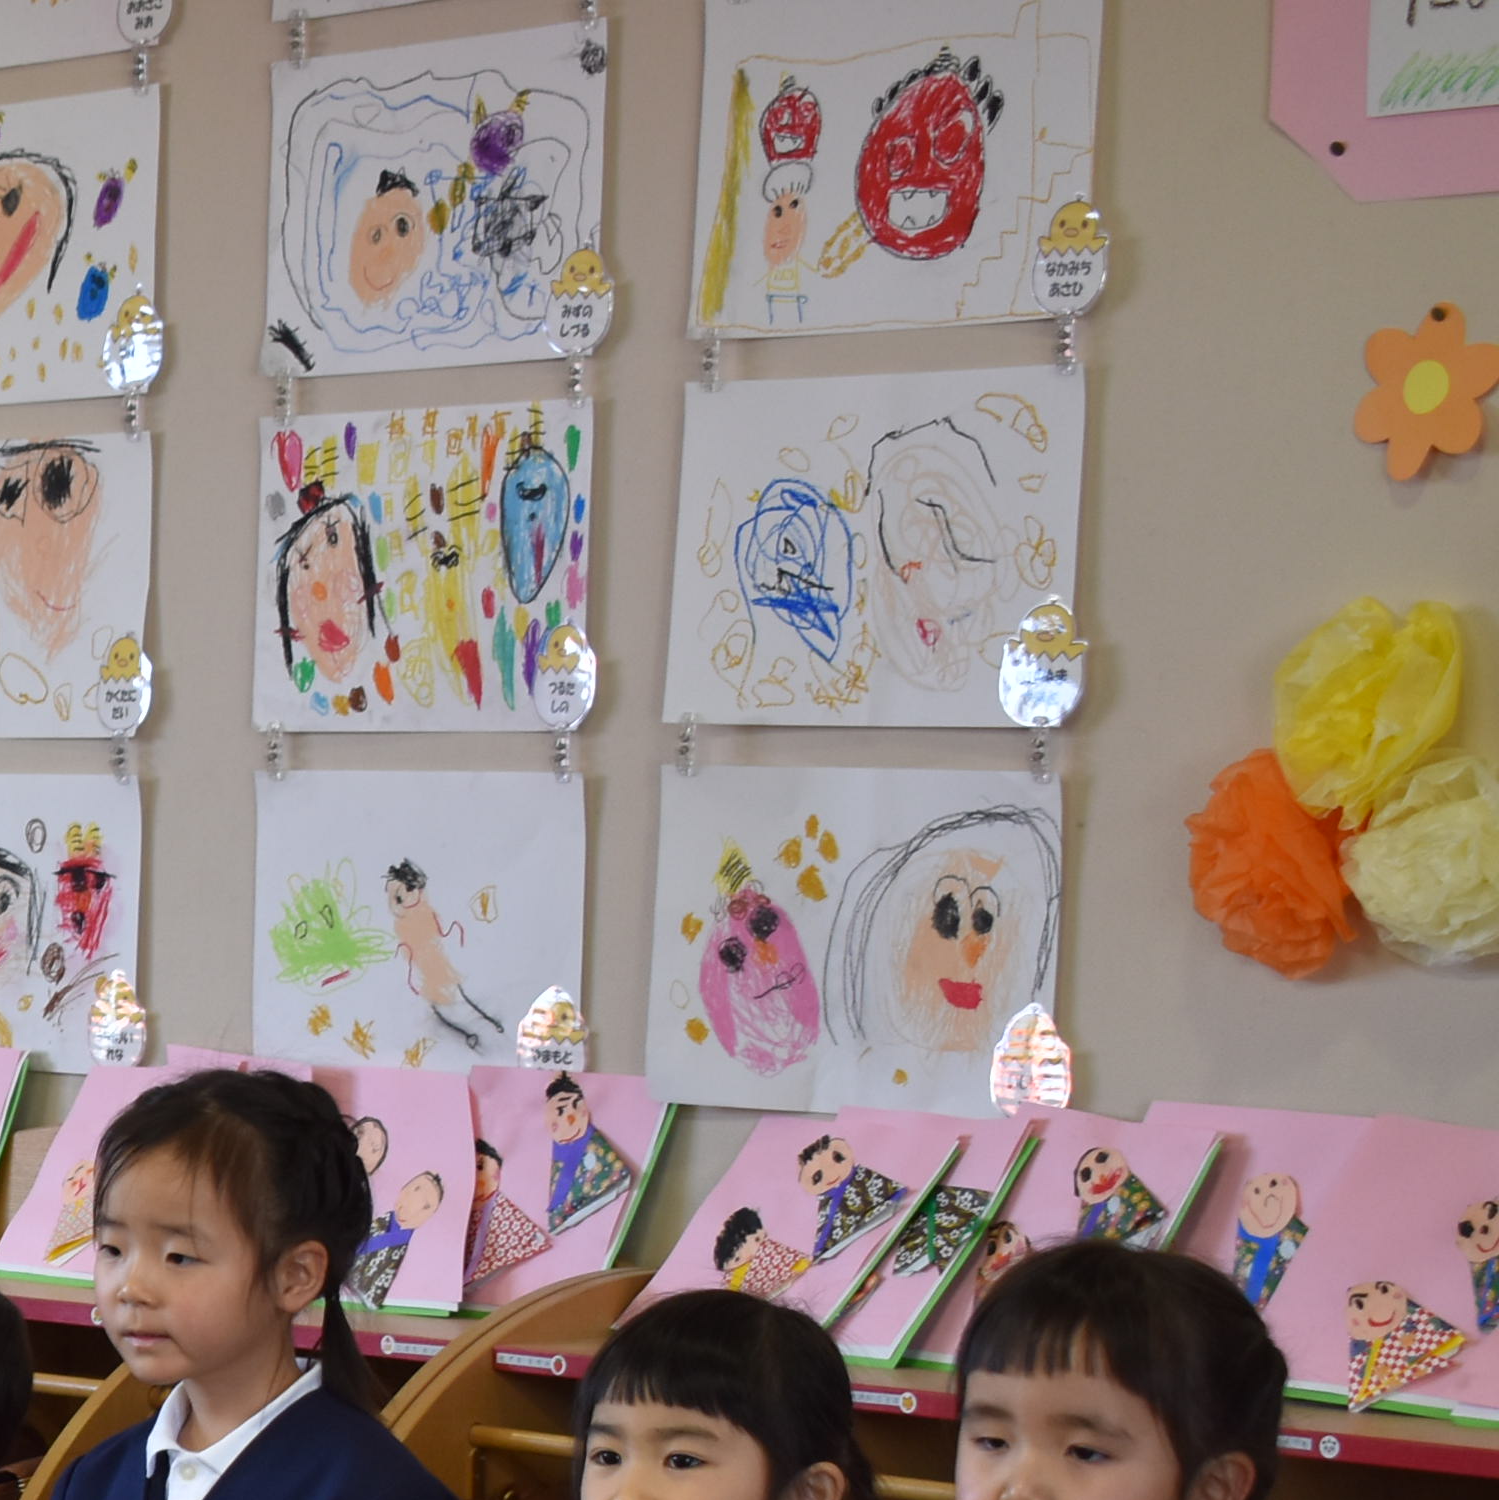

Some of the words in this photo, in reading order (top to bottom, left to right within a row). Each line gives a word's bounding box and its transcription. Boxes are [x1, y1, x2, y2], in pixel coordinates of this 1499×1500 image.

[1045, 261, 1092, 277] なかみち
[1048, 281, 1084, 298] あさひ
[561, 304, 593, 319] みずの
[105, 688, 137, 703] かくたに
[550, 699, 571, 714] しの
